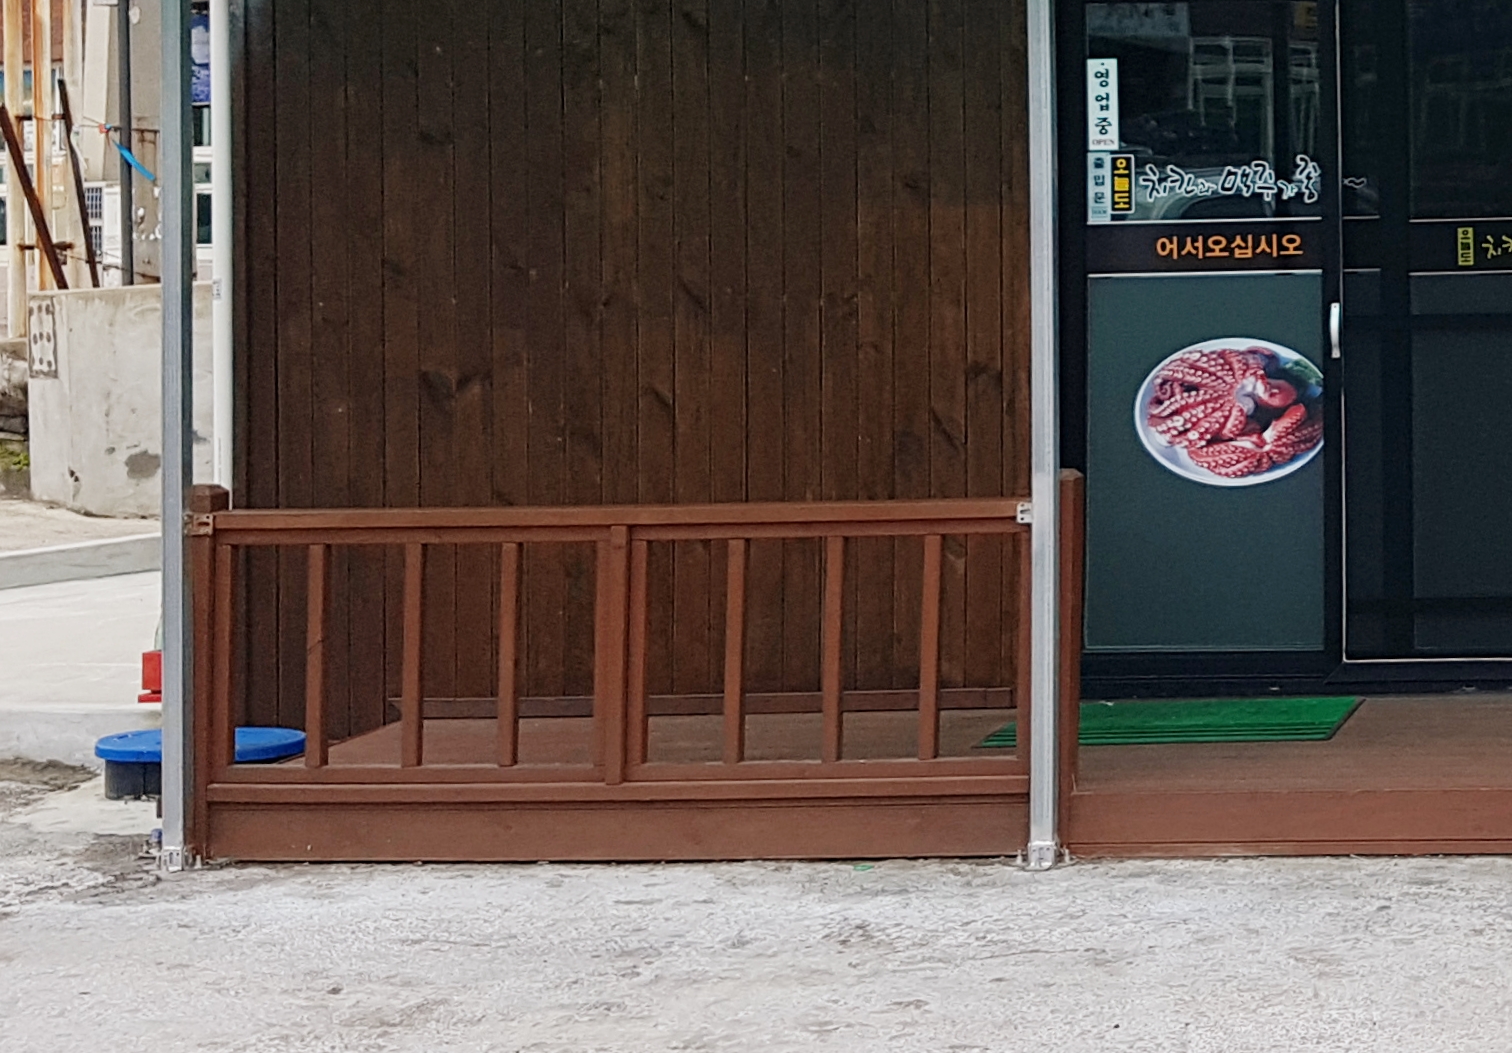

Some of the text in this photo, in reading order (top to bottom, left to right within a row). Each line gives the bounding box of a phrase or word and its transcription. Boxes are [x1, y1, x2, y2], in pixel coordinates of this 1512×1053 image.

[1094, 68, 1113, 136] 영업중
[1092, 138, 1115, 146] OPEN
[1139, 163, 1217, 203] 치킨과
[1218, 160, 1298, 201] 맥주가
[1156, 233, 1304, 259] 어서오십시오
